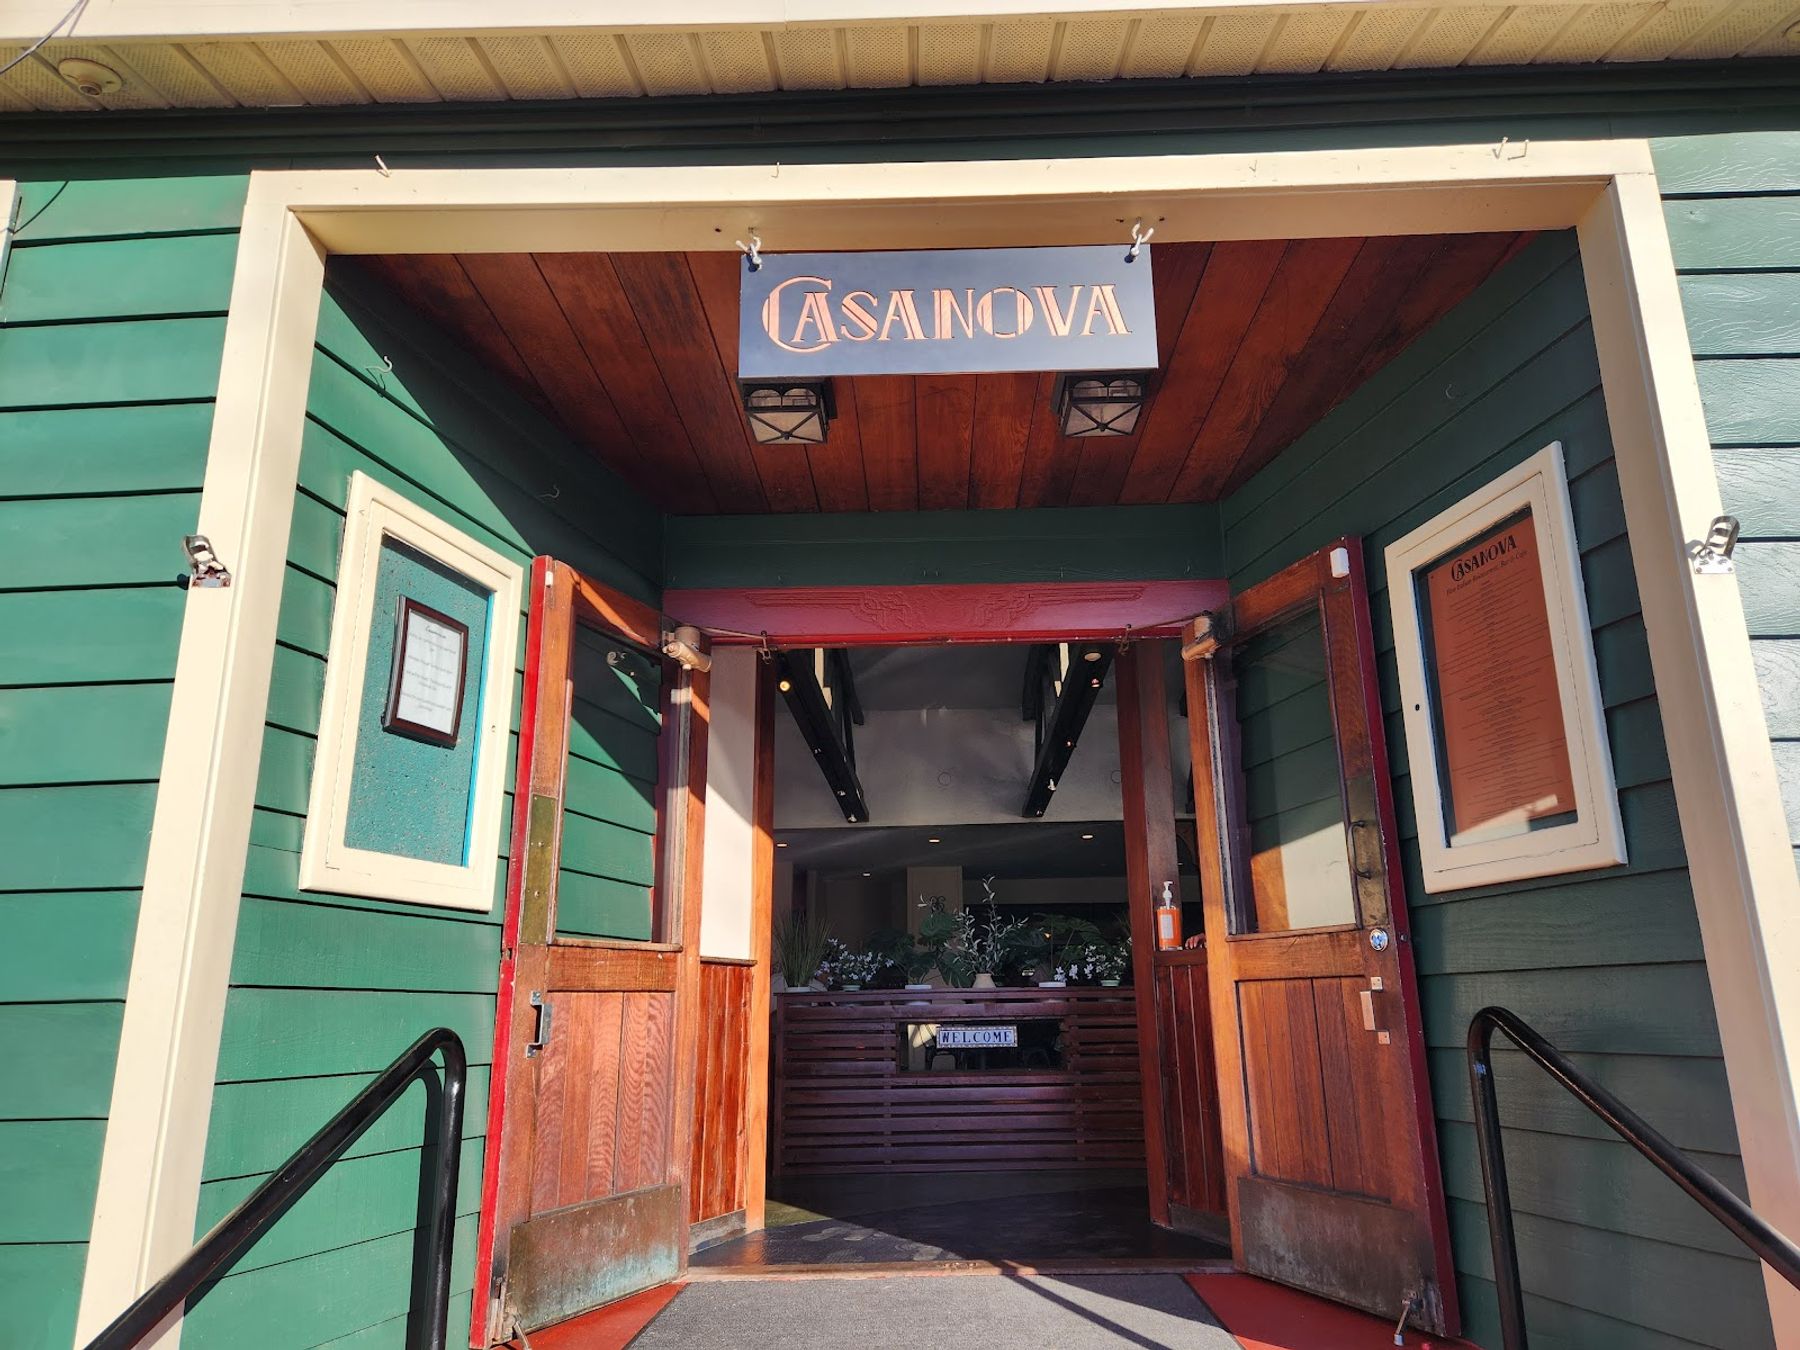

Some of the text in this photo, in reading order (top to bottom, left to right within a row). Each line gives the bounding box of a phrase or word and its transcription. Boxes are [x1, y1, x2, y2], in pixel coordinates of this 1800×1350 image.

[762, 275, 1132, 353] CASANOVA
[1451, 534, 1517, 582] CASANOVA
[942, 1031, 1011, 1043] WELCOME
